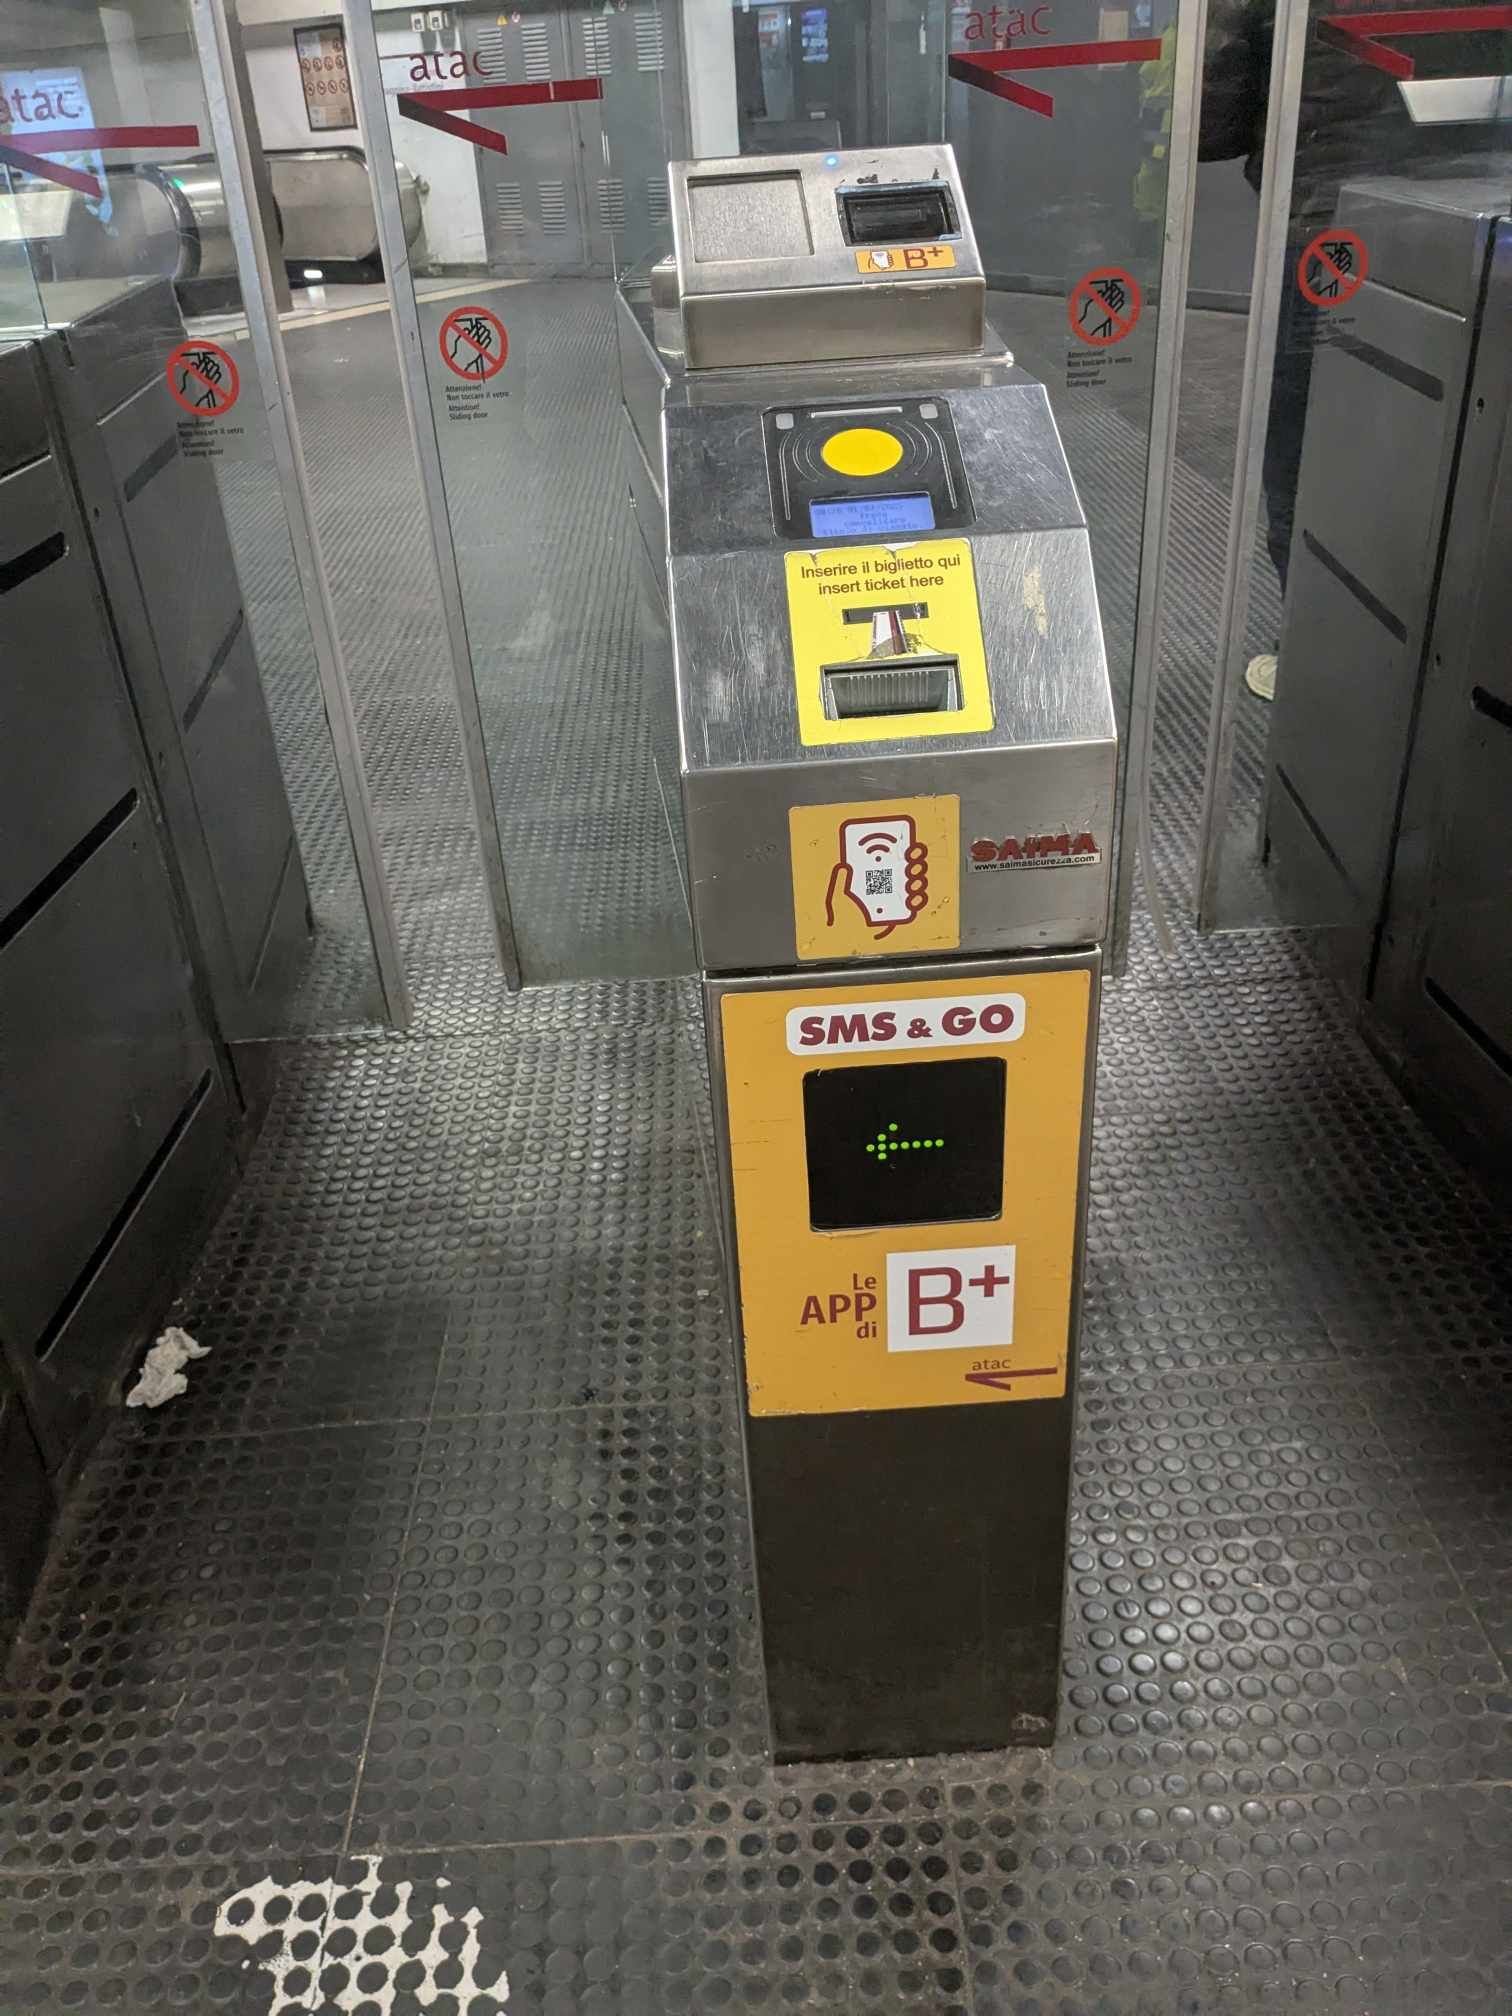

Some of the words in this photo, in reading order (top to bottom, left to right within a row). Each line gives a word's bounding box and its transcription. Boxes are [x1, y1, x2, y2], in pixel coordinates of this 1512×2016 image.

[965, 4, 1052, 41] atac
[409, 50, 492, 82] atac
[801, 564, 857, 579] Inserire
[862, 561, 870, 574] il
[874, 556, 933, 574] biglietto
[938, 554, 961, 569] qui
[818, 580, 861, 595] insert
[864, 577, 906, 592] ticket
[909, 575, 944, 588] here
[970, 831, 1099, 862] SAIMA
[799, 1011, 897, 1046] SMS
[906, 1018, 933, 1039] &
[941, 1004, 1014, 1036] GO
[853, 1273, 877, 1290] Le
[800, 1292, 878, 1325] APP
[908, 1264, 1010, 1336] B+
[856, 1321, 877, 1339] di
[972, 1358, 1011, 1371] atac
